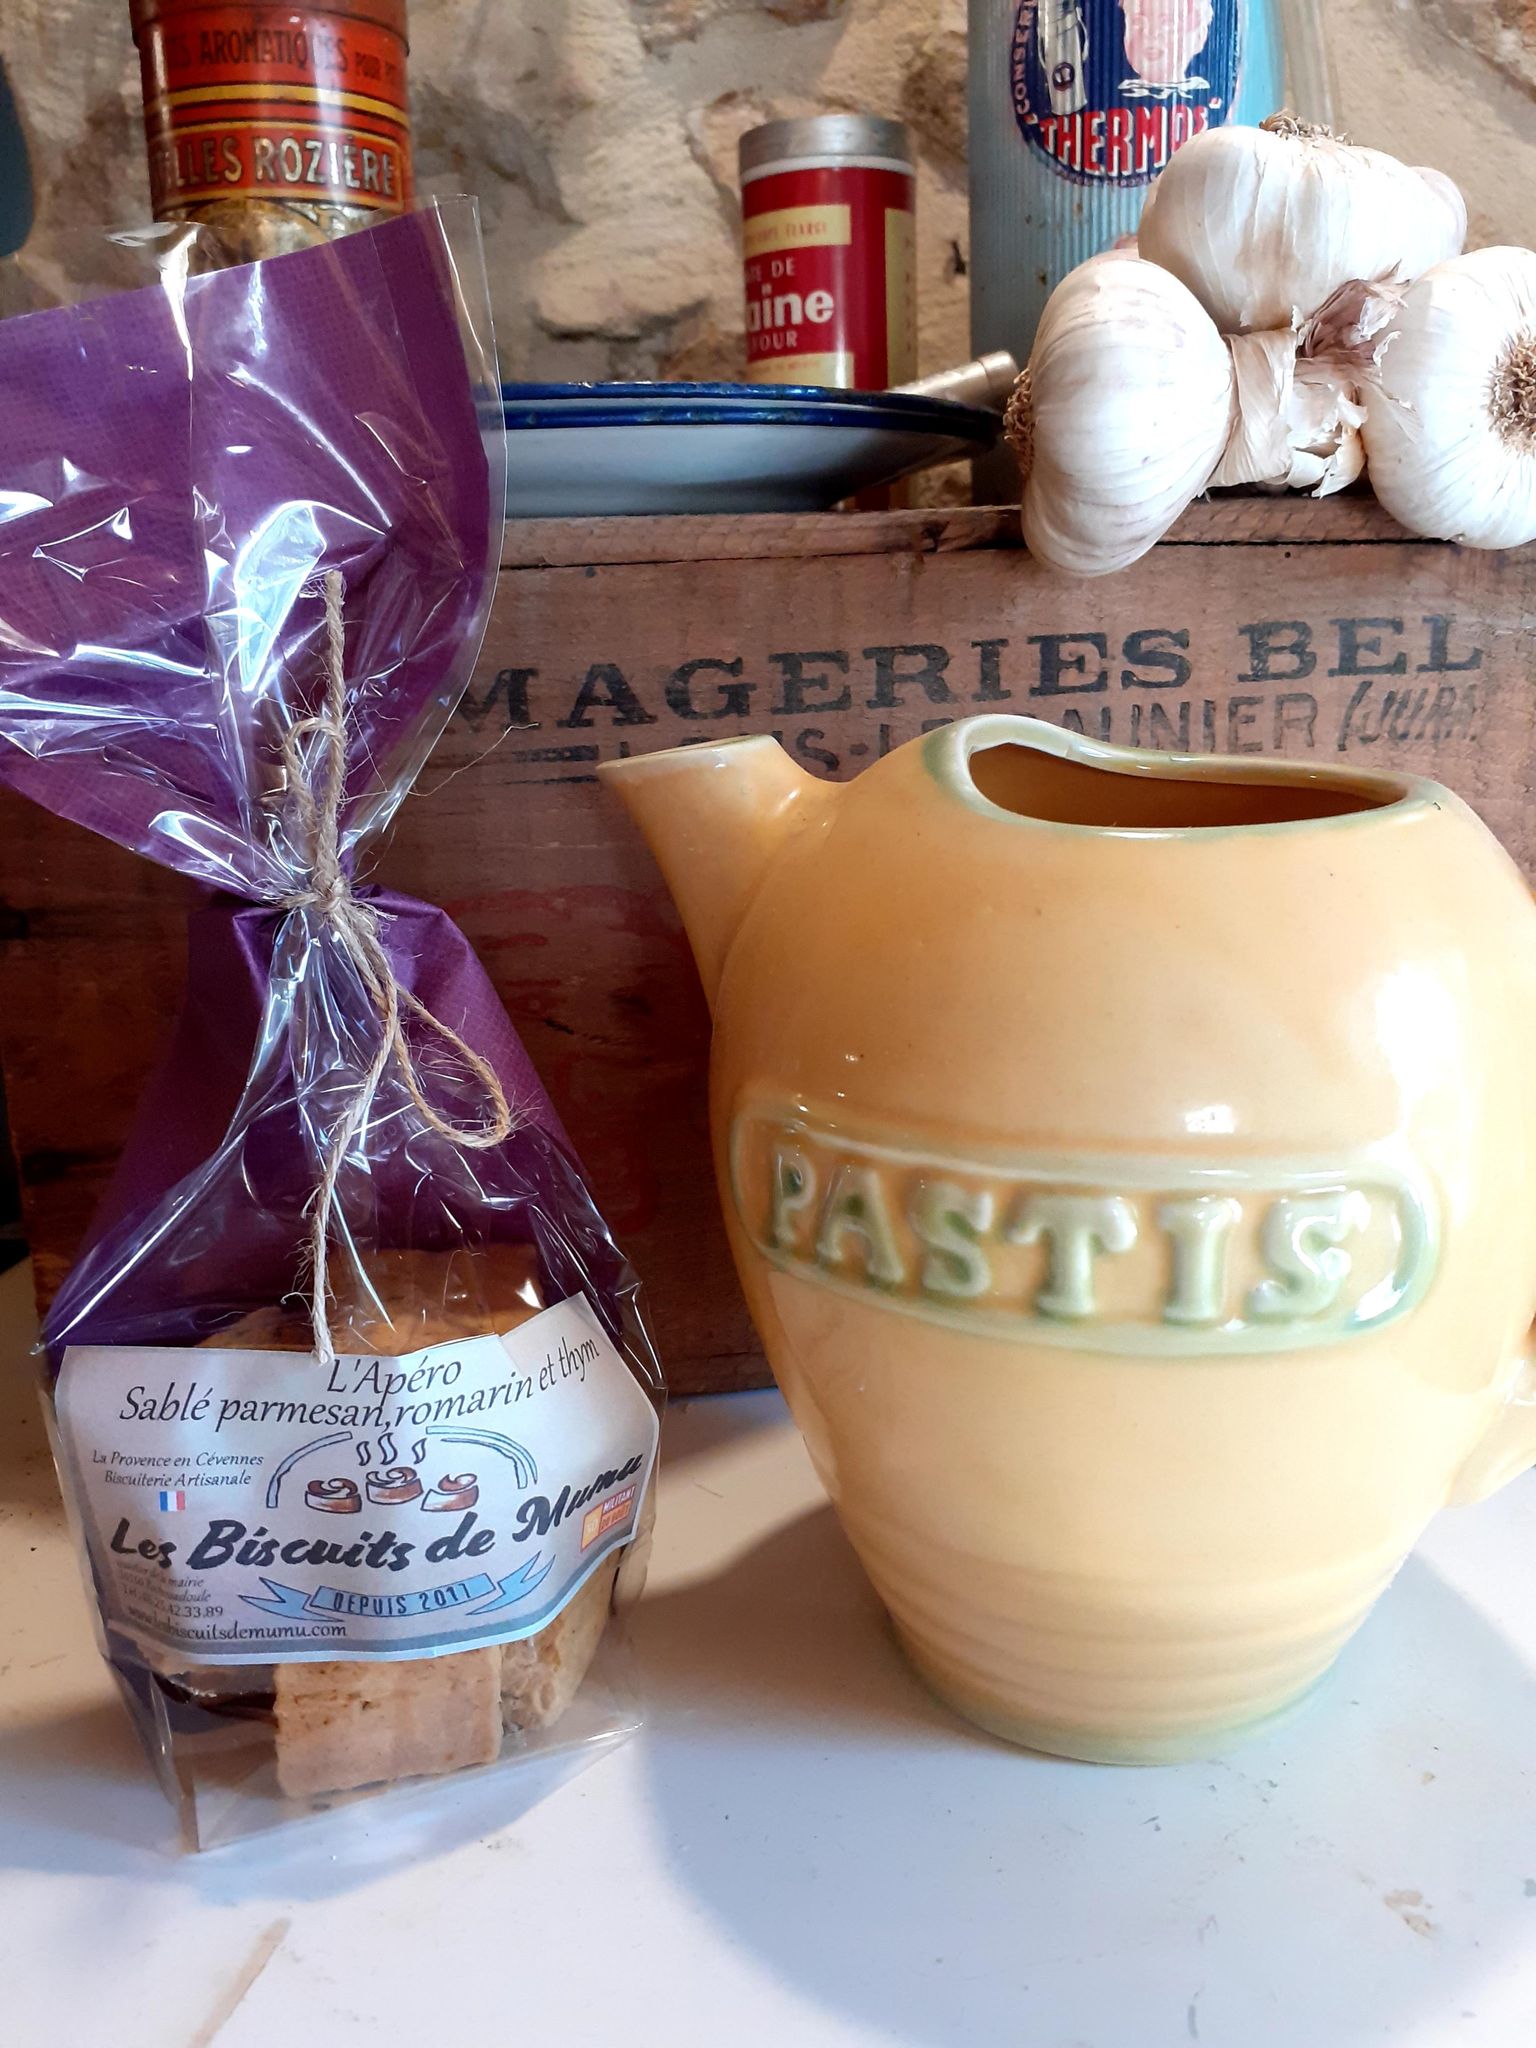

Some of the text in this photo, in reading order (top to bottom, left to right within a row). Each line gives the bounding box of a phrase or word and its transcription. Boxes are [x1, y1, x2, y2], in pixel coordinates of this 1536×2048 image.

[200, 28, 349, 75] AROMATIQES
[1237, 613, 1485, 683] BEL
[768, 1145, 1373, 1325] PASTIS
[119, 1382, 214, 1422] Sablé
[538, 1353, 558, 1392] et
[557, 1336, 602, 1382] thym
[326, 1355, 463, 1407] L'Apéro
[92, 1450, 265, 1468] La Provence en Cévennes
[104, 1470, 252, 1488] Biscuiterie Artisanale
[110, 1517, 177, 1569] Les
[186, 1519, 415, 1572] Biscuits
[425, 1511, 496, 1565] de
[512, 1452, 645, 1544] Mumu
[333, 1592, 407, 1615] DEPUIS
